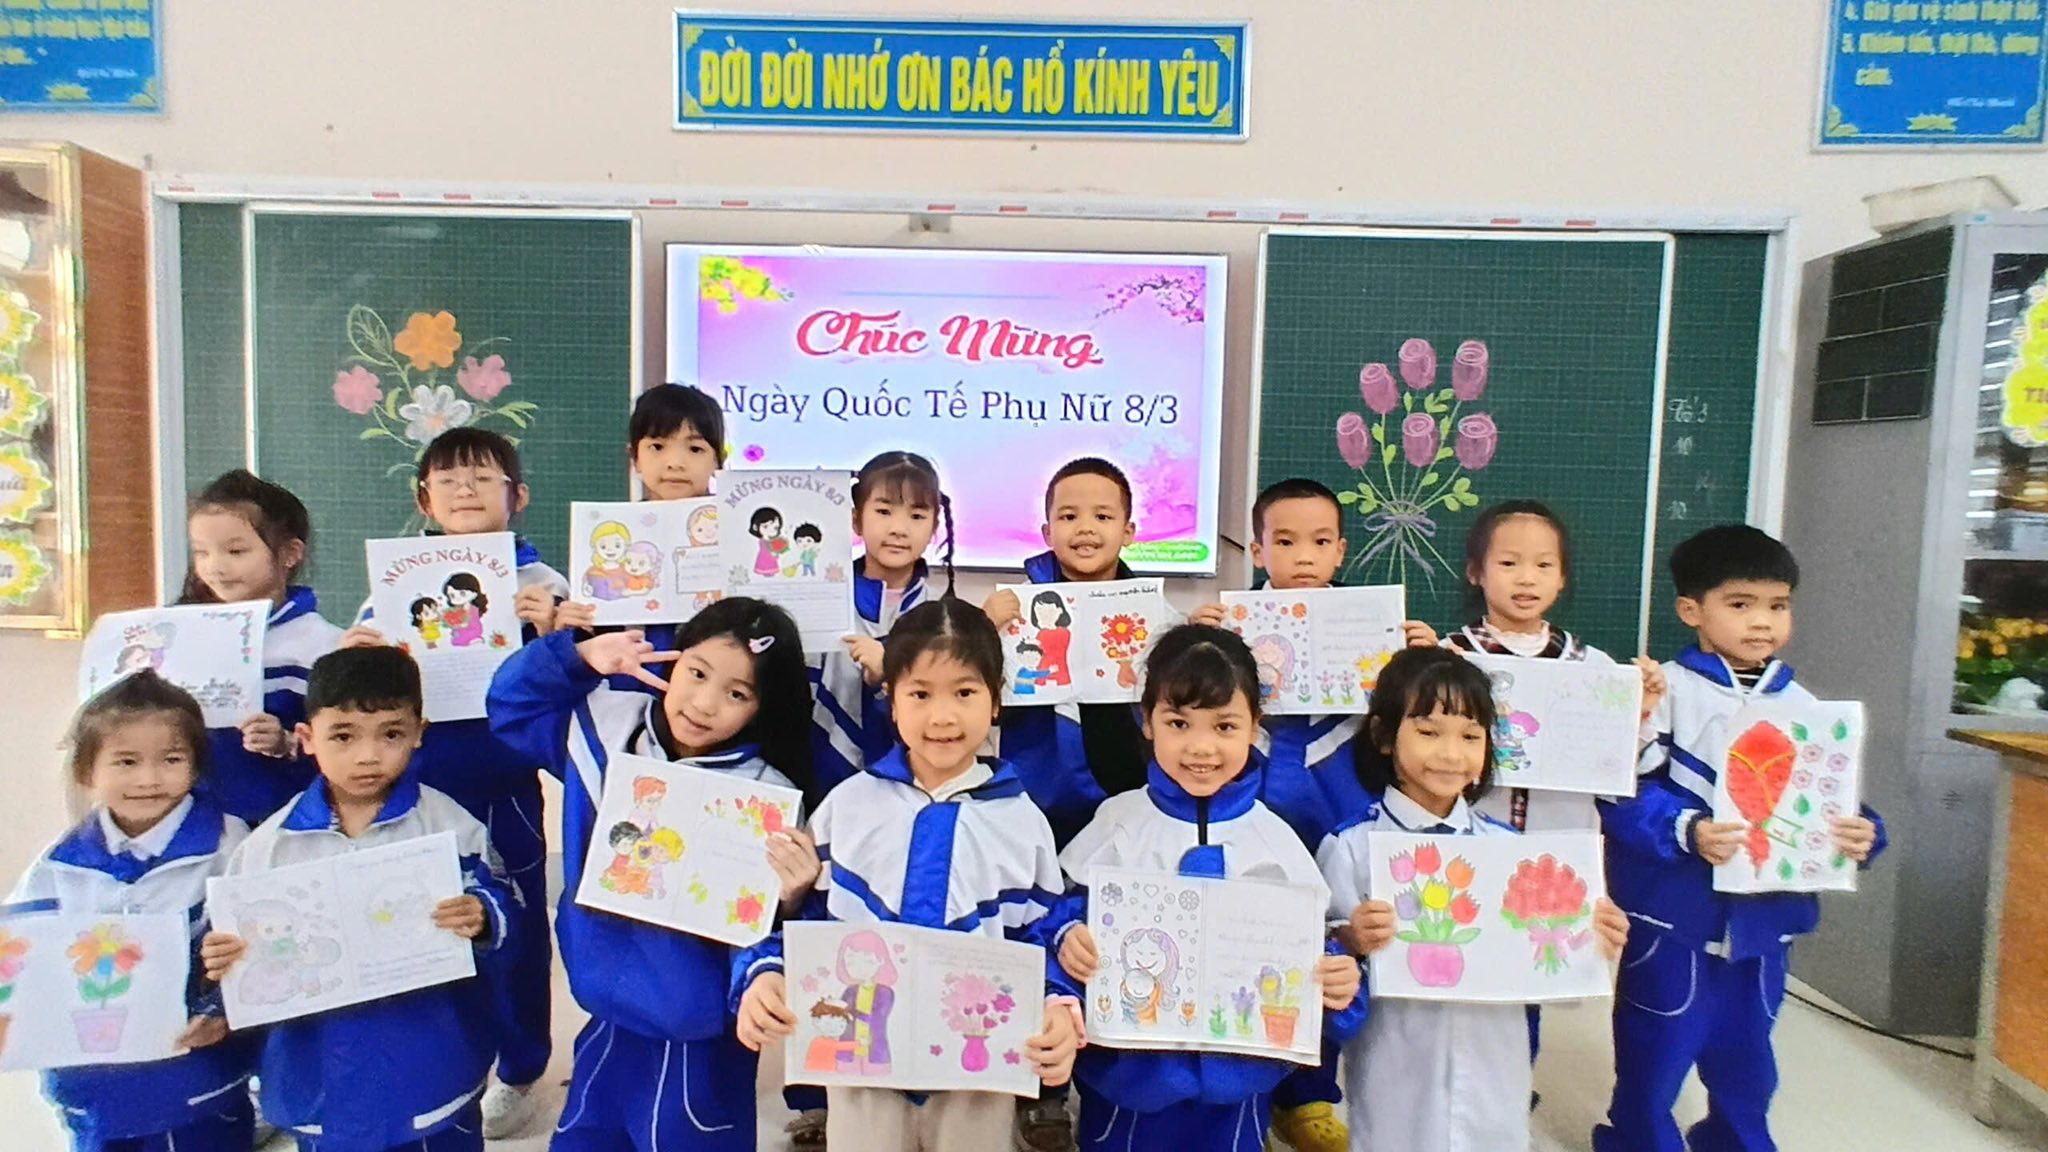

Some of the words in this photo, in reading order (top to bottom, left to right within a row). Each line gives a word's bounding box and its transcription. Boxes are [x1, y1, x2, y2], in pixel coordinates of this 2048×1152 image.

[699, 35, 752, 107] ĐỜI
[760, 37, 813, 109] ĐỜI
[823, 37, 890, 110] NHỚ
[897, 51, 941, 111] ƠN
[950, 45, 1014, 113] BÁC
[1022, 39, 1065, 114] HỒ
[1073, 46, 1150, 115] KÍNH
[1159, 48, 1219, 116] YÊU
[797, 310, 928, 356] Chúc
[939, 315, 1104, 369] Mừng
[722, 383, 810, 422] Ngày
[823, 378, 911, 421] Quốc
[925, 380, 967, 418] Tế
[981, 391, 1047, 427] Phụ
[1060, 393, 1112, 422] Nữ
[1125, 394, 1178, 426] 8/3
[724, 477, 773, 508] MỪNG
[777, 475, 825, 493] NGÀY
[825, 487, 846, 506] 8/3
[380, 552, 432, 586] MỪNG
[435, 547, 488, 565] NGÀY
[487, 558, 509, 578] 8/3
